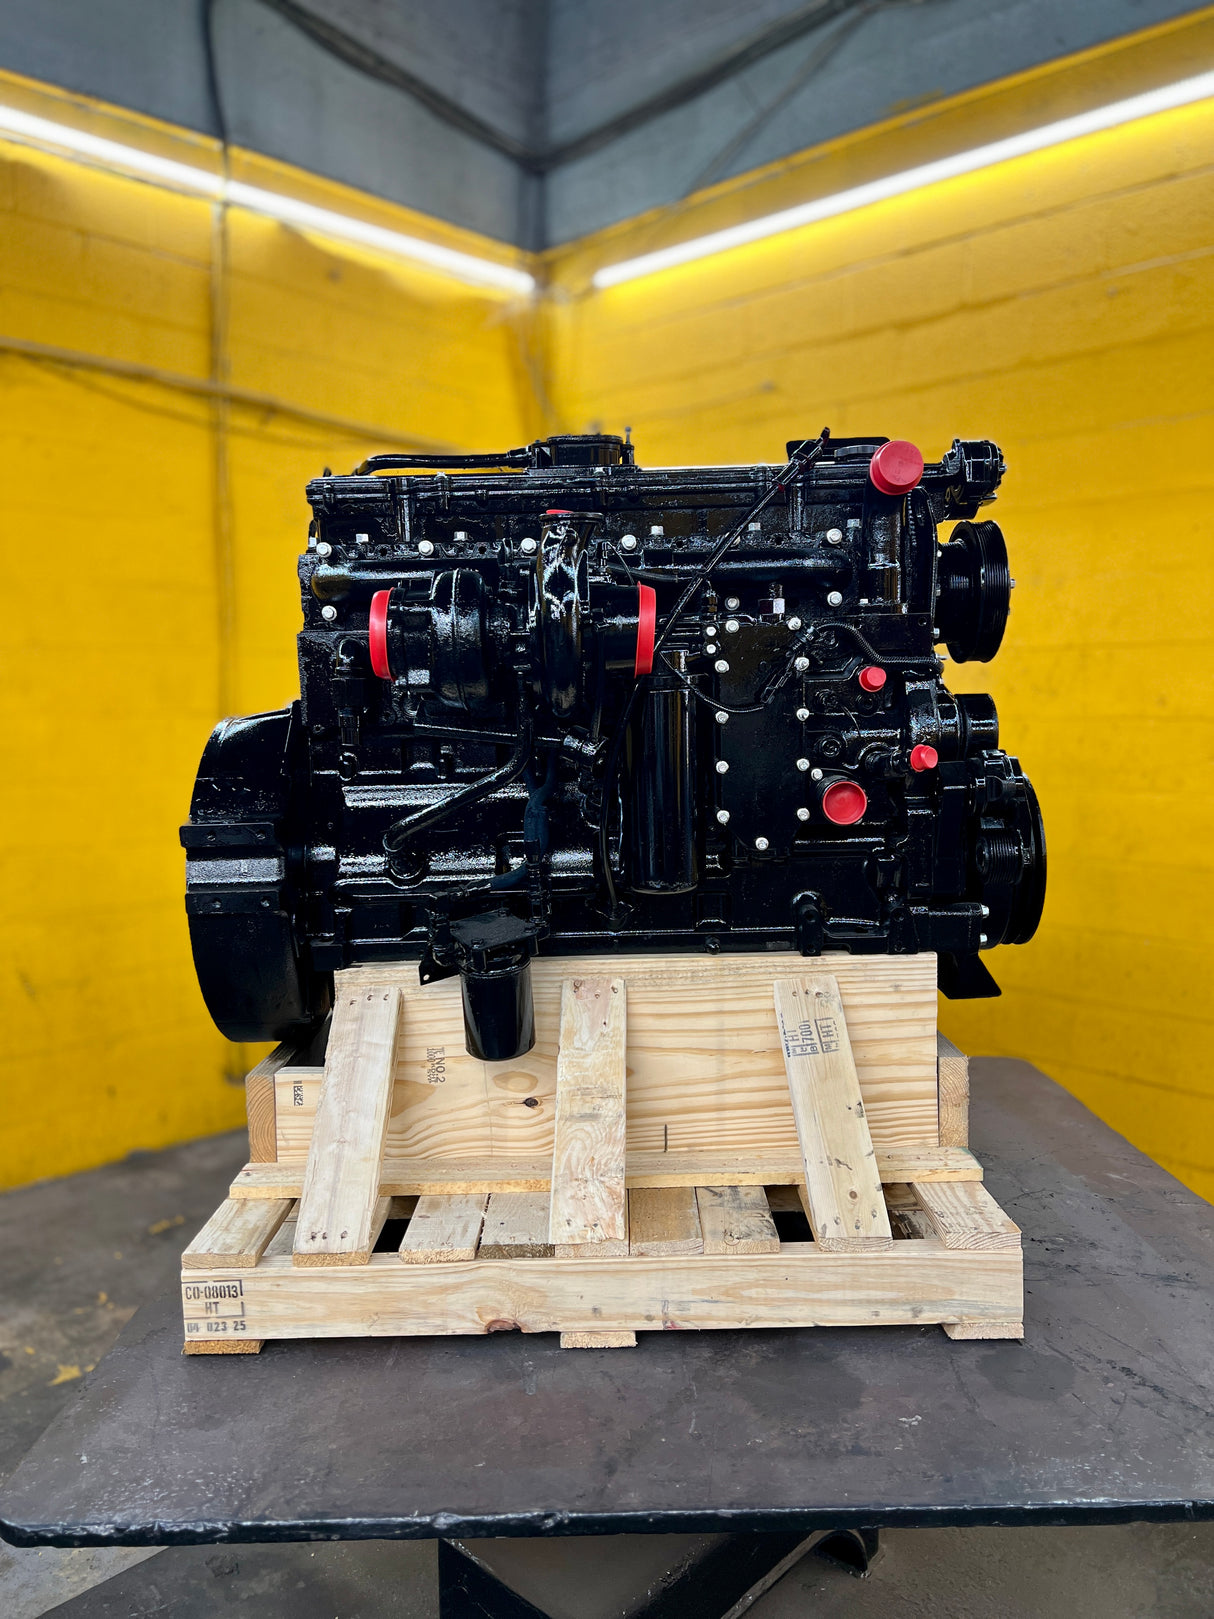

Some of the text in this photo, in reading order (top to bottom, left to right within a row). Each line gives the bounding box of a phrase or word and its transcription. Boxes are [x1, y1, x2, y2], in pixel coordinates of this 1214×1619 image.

[820, 1024, 834, 1038] HT
[204, 1301, 220, 1315] HT
[234, 1320, 247, 1331] 25
